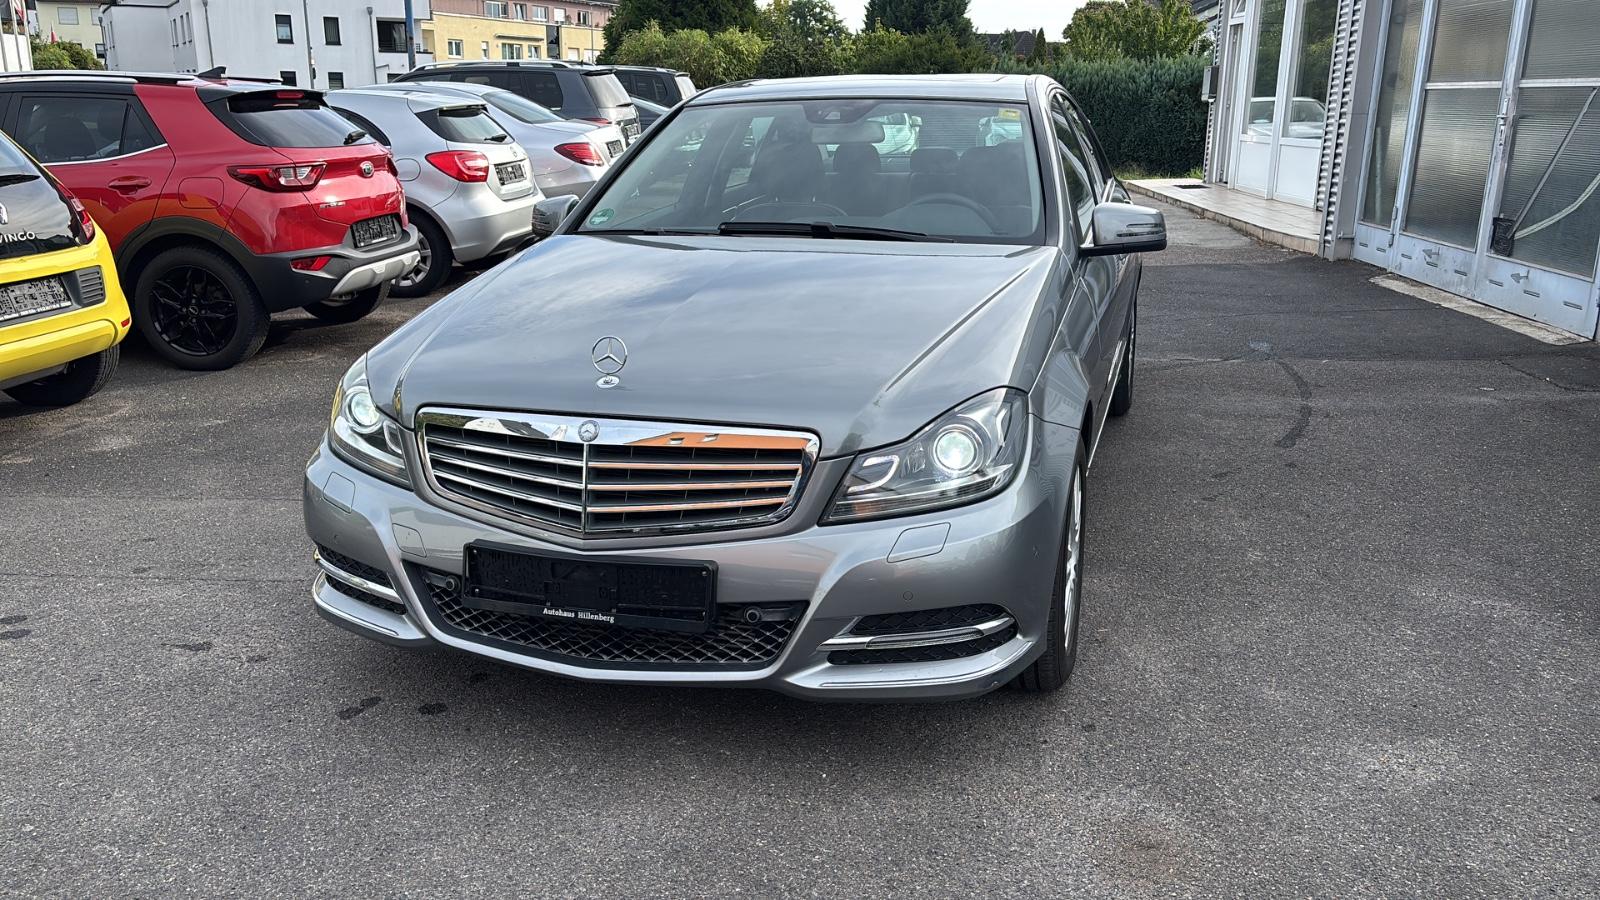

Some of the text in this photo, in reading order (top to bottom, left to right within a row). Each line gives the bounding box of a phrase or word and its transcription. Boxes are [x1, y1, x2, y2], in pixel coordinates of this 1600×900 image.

[0, 231, 36, 243] INGO
[542, 607, 615, 624] Autohaus Hillenberg
